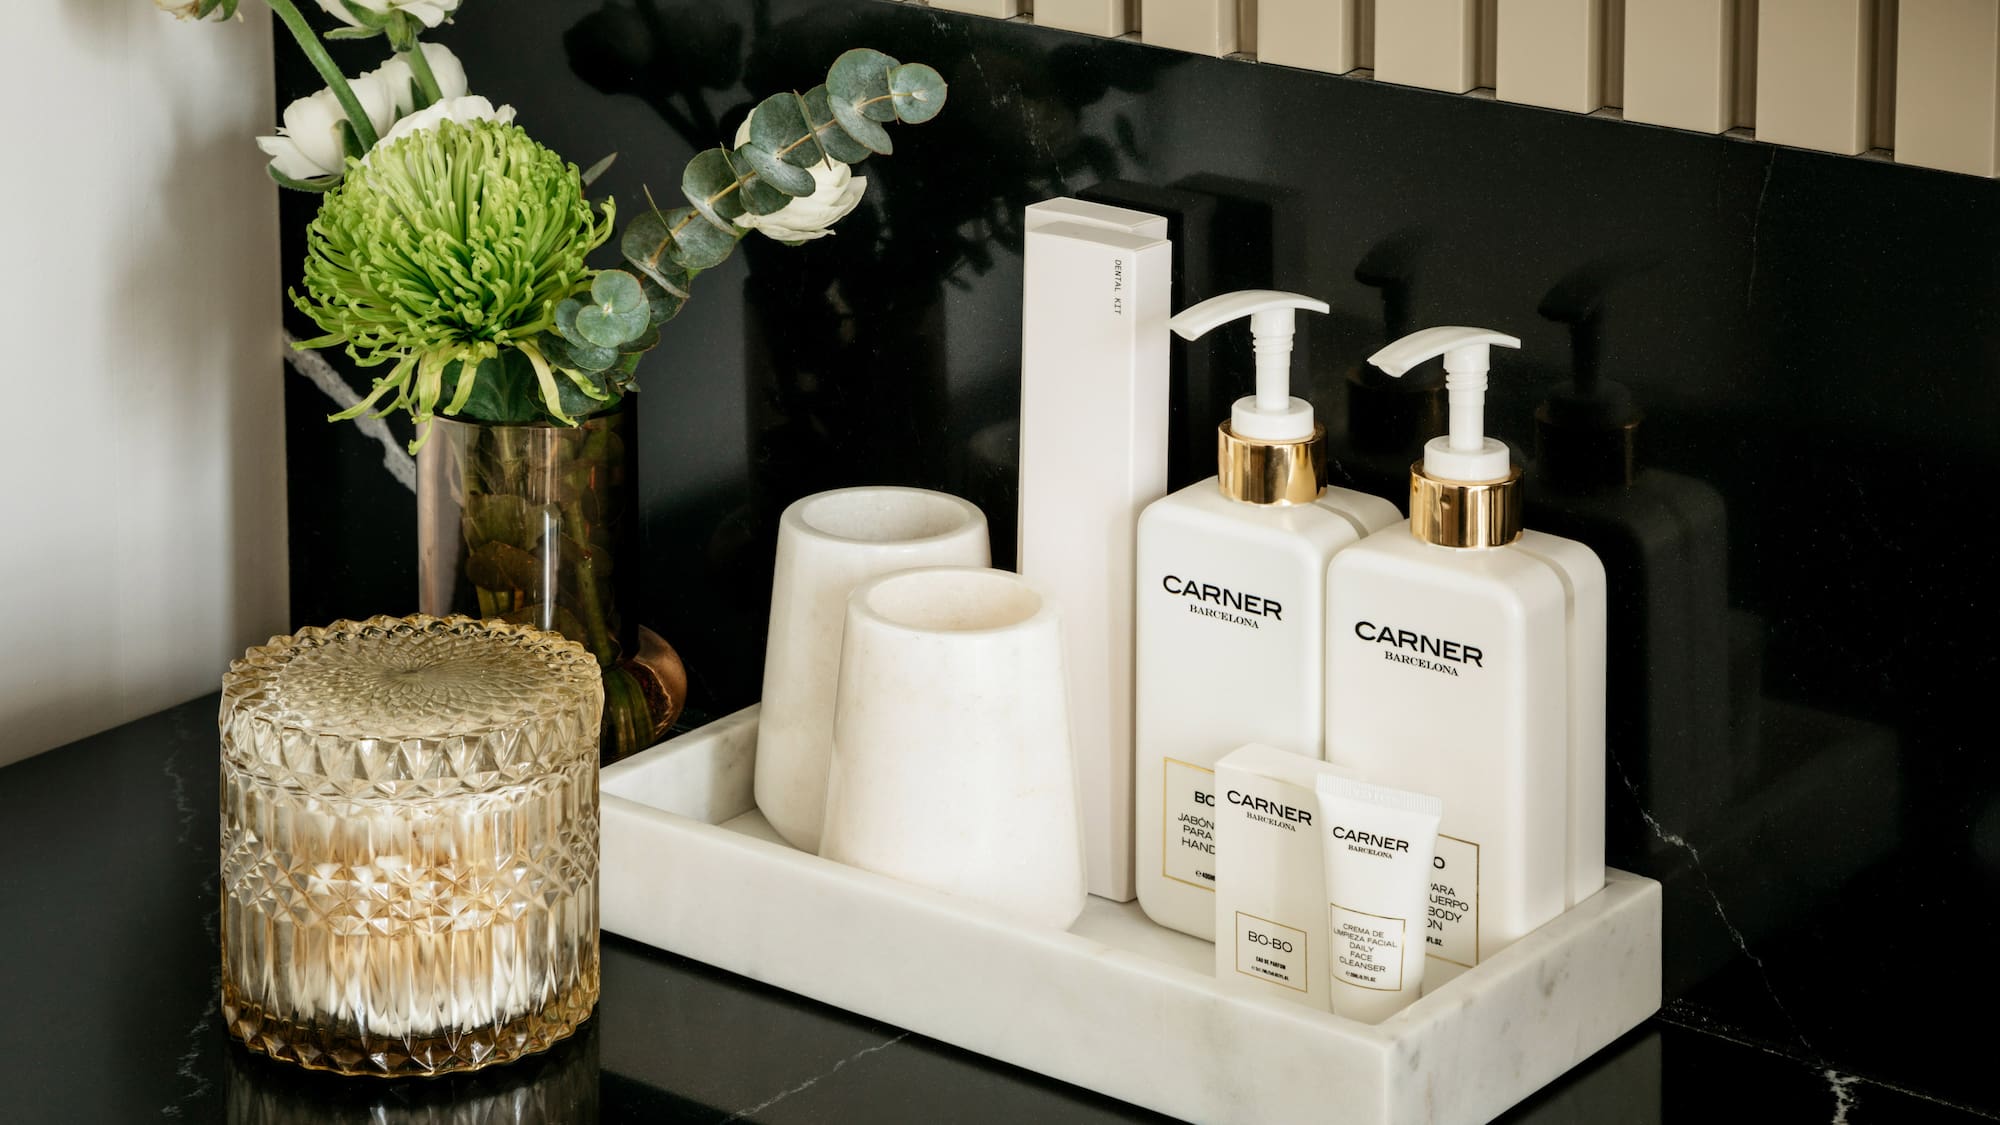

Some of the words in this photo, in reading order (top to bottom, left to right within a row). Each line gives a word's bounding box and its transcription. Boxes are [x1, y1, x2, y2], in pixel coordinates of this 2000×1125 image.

[1114, 259, 1122, 292] DENTAL
[1114, 297, 1122, 316] KIT
[1162, 574, 1283, 621] CARNER
[1189, 604, 1260, 629] BARCELONA
[1354, 620, 1484, 668] CARNER
[1384, 650, 1460, 677] BARCELONA
[1226, 789, 1312, 827] CARNER
[1177, 812, 1215, 830] JABÓN
[1246, 811, 1297, 833] BARCELONA
[1183, 824, 1213, 841] PARA
[1332, 826, 1410, 853] CARNER
[1347, 844, 1393, 860] BARCELONA
[1430, 882, 1456, 897] ARA
[1429, 893, 1469, 912] UERPO
[1427, 905, 1462, 923] BODY
[1342, 922, 1370, 937] CREMA
[1372, 929, 1385, 939] DE
[1248, 930, 1293, 953] BO-BO
[1349, 941, 1375, 953] DAILY
[1366, 937, 1398, 948] FACIAL
[1338, 955, 1386, 973] CLEANSER
[1350, 950, 1373, 962] FACE
